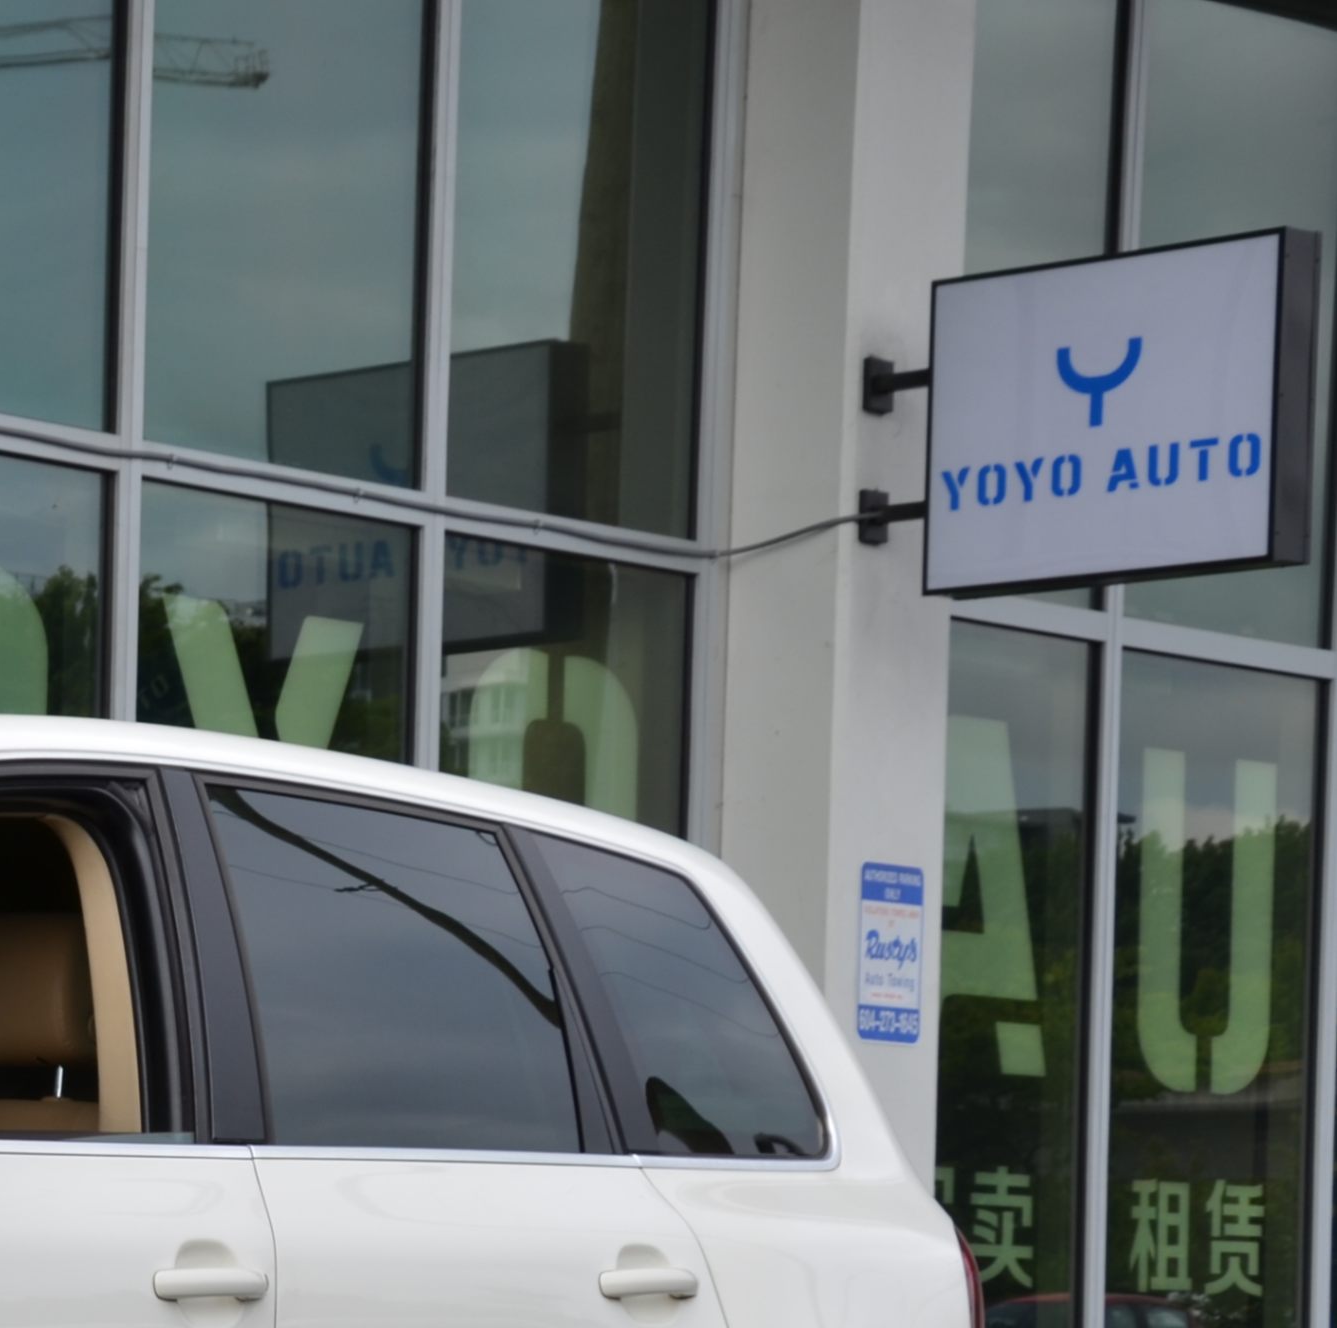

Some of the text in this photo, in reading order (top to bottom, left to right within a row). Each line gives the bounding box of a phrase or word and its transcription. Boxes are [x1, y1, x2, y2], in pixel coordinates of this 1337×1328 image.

[941, 433, 1262, 512] YOYO AUTO
[864, 929, 918, 970] Rusty's
[935, 1166, 1265, 1298] 卖 租赁
